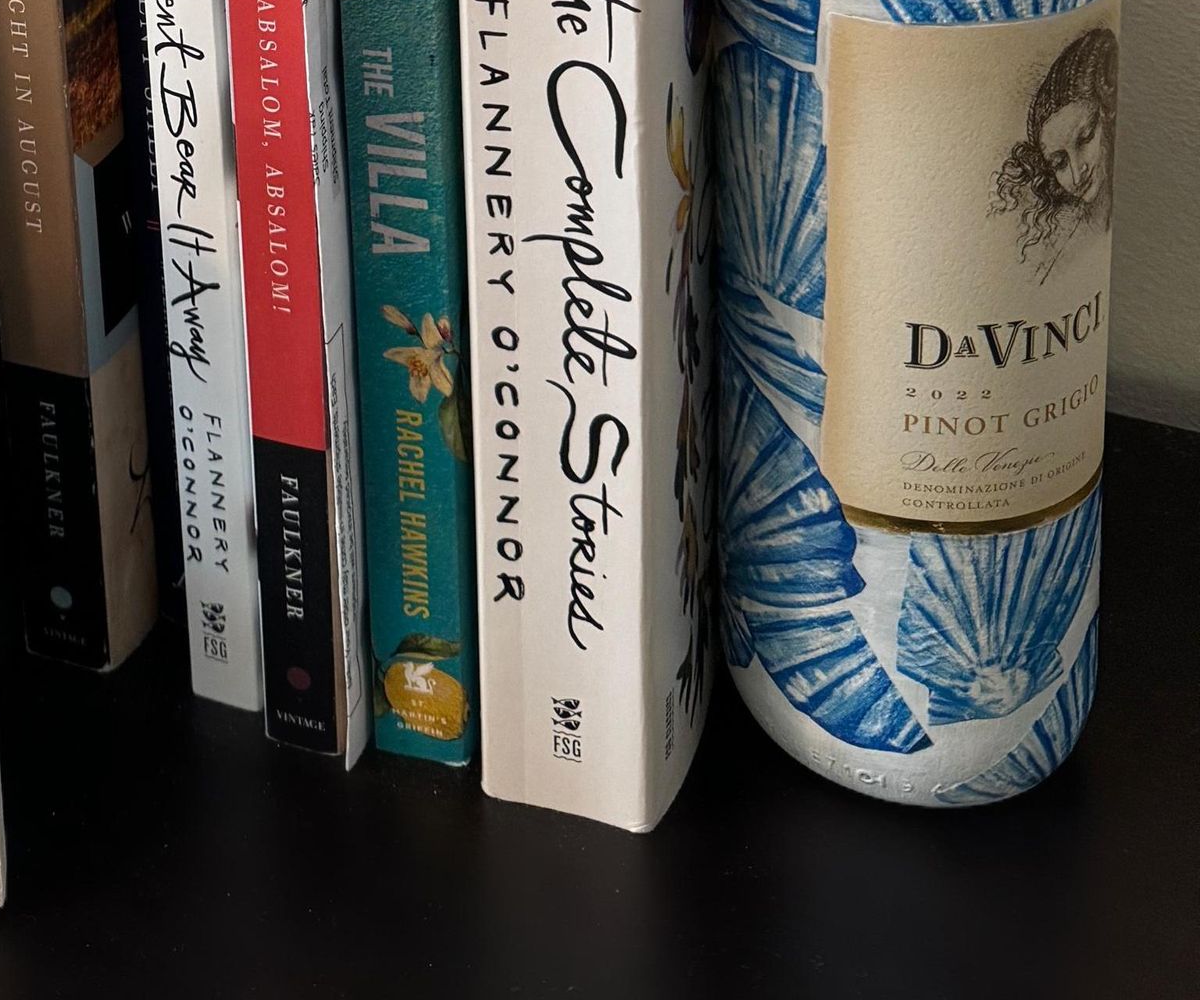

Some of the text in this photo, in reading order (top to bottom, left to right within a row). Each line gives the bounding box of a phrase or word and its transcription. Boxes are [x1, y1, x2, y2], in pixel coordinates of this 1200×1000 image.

[14, 72, 33, 105] IN
[160, 62, 201, 218] Bear
[318, 101, 329, 174] Shipping
[321, 65, 331, 109] Total
[18, 119, 43, 234] AUGUST
[328, 107, 339, 184] Shipment
[362, 46, 431, 256] THE VILLA
[168, 222, 217, 256] It
[265, 162, 292, 316] ABSALOM!
[521, 60, 638, 387] Complete
[168, 257, 221, 384] Away
[902, 374, 1099, 436] PINOT GRIGIO
[905, 386, 992, 401] 2022
[39, 400, 66, 539] FAULKNER
[179, 404, 203, 563] O'CONNOR
[202, 412, 231, 575] FLANNERY
[395, 408, 430, 620] RACHEL HAWKINS
[491, 325, 526, 603] O'CONNOR
[546, 379, 630, 651] Stories
[901, 497, 1011, 511] CONTROLLATA
[902, 451, 1087, 495] DENOMINAZIONE DI ORIGINE
[280, 472, 304, 620] FAULKNER
[203, 635, 228, 660] FSG
[276, 709, 326, 732] VINTAGE
[552, 734, 582, 758] FSG
